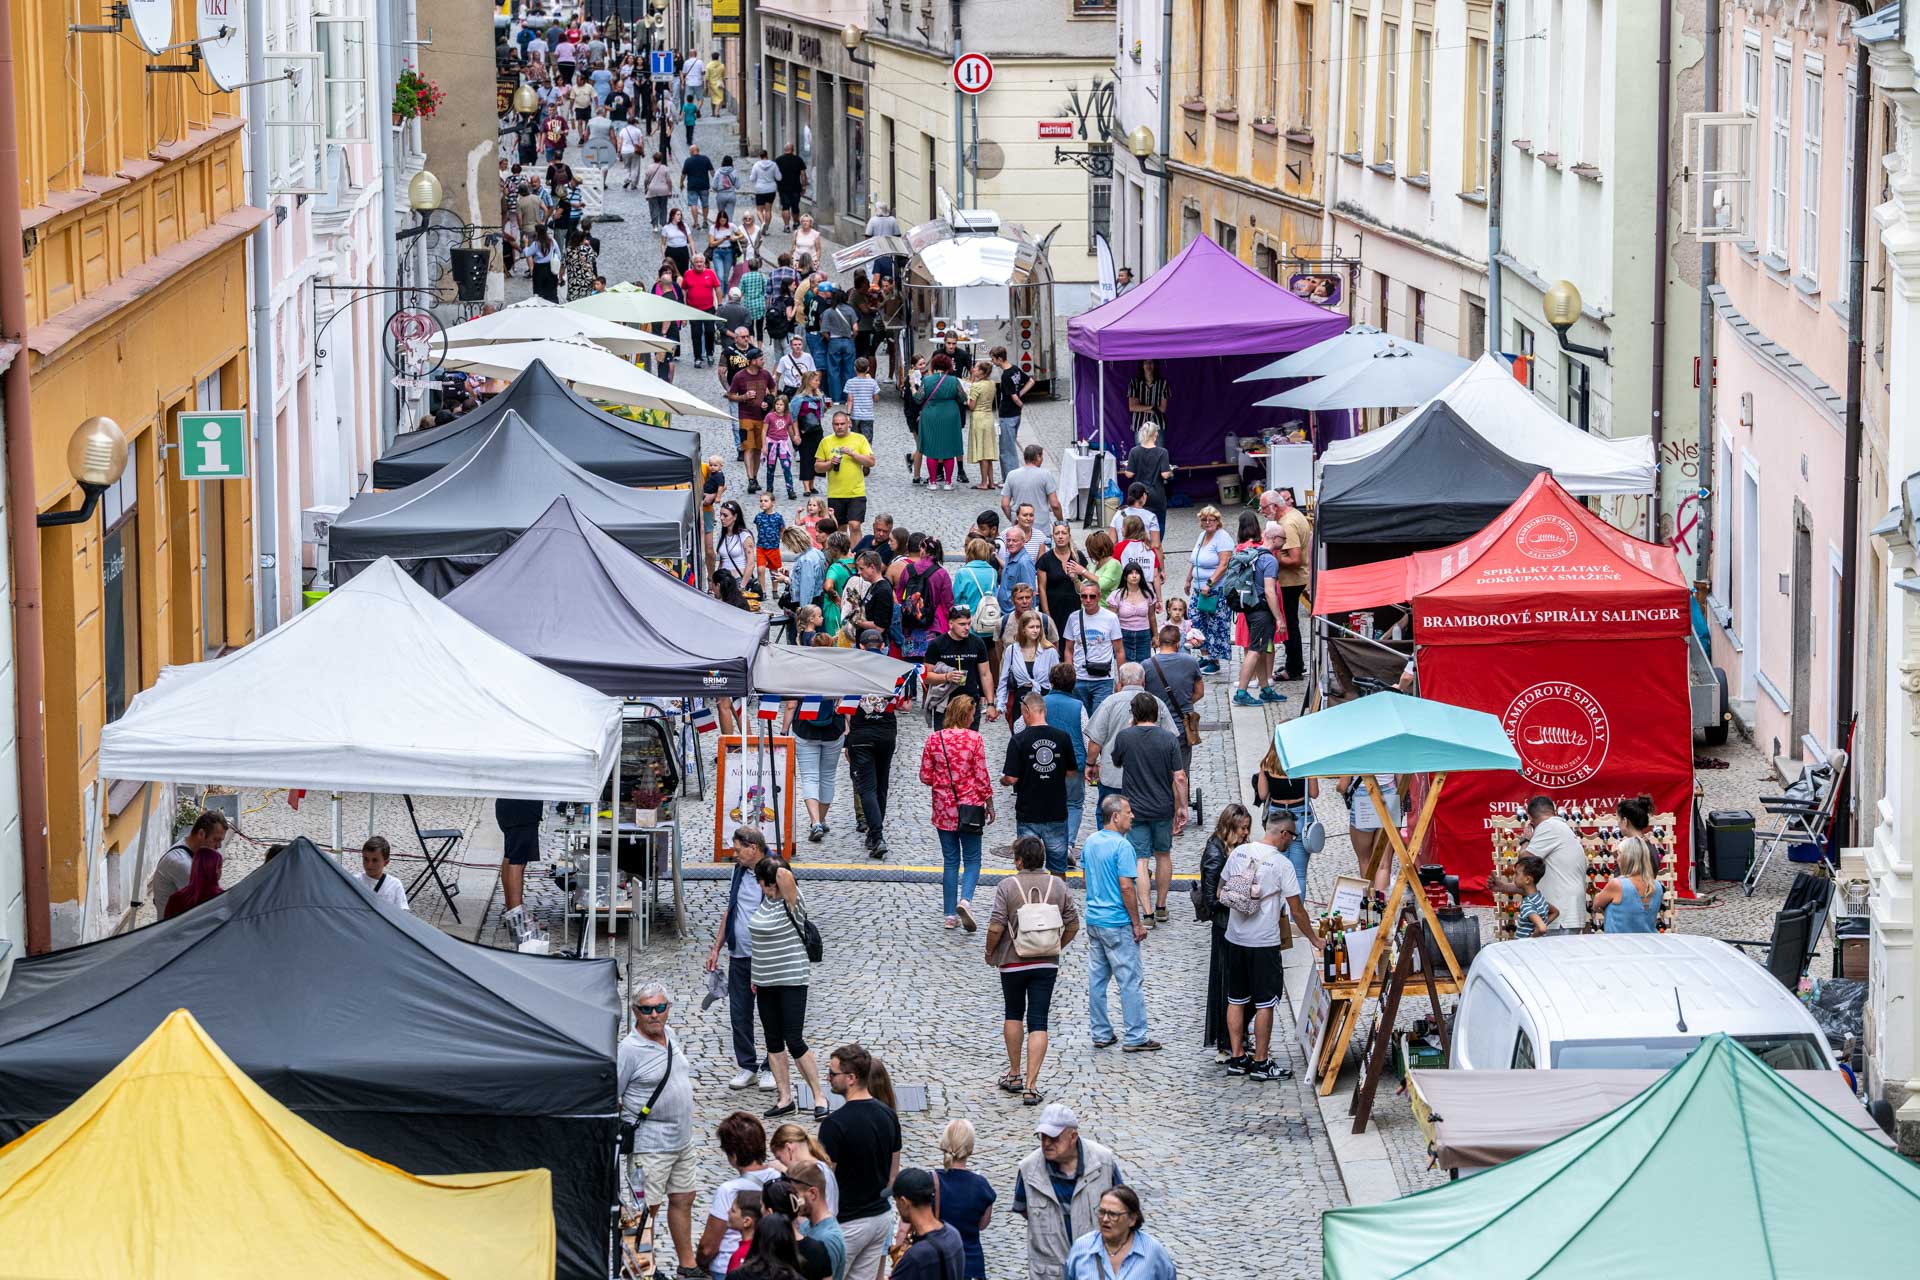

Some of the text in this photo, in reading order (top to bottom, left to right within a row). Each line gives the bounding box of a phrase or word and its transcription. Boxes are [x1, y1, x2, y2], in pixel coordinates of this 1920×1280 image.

[1528, 549, 1567, 558] SALINGER
[1483, 564, 1615, 577] SPIRÁLKY ZLATAVÉ,
[1476, 571, 1622, 585] DOKŘUPAVA SMAŽENÉ
[1423, 608, 1680, 628] BRAMBOROVÉ SPIRÁLY SALINGER
[702, 676, 727, 684] BRIMO
[1573, 691, 1606, 742] SPIRÁLY
[1532, 756, 1569, 770] ZALOŽENO
[1525, 763, 1594, 785] SALINGER
